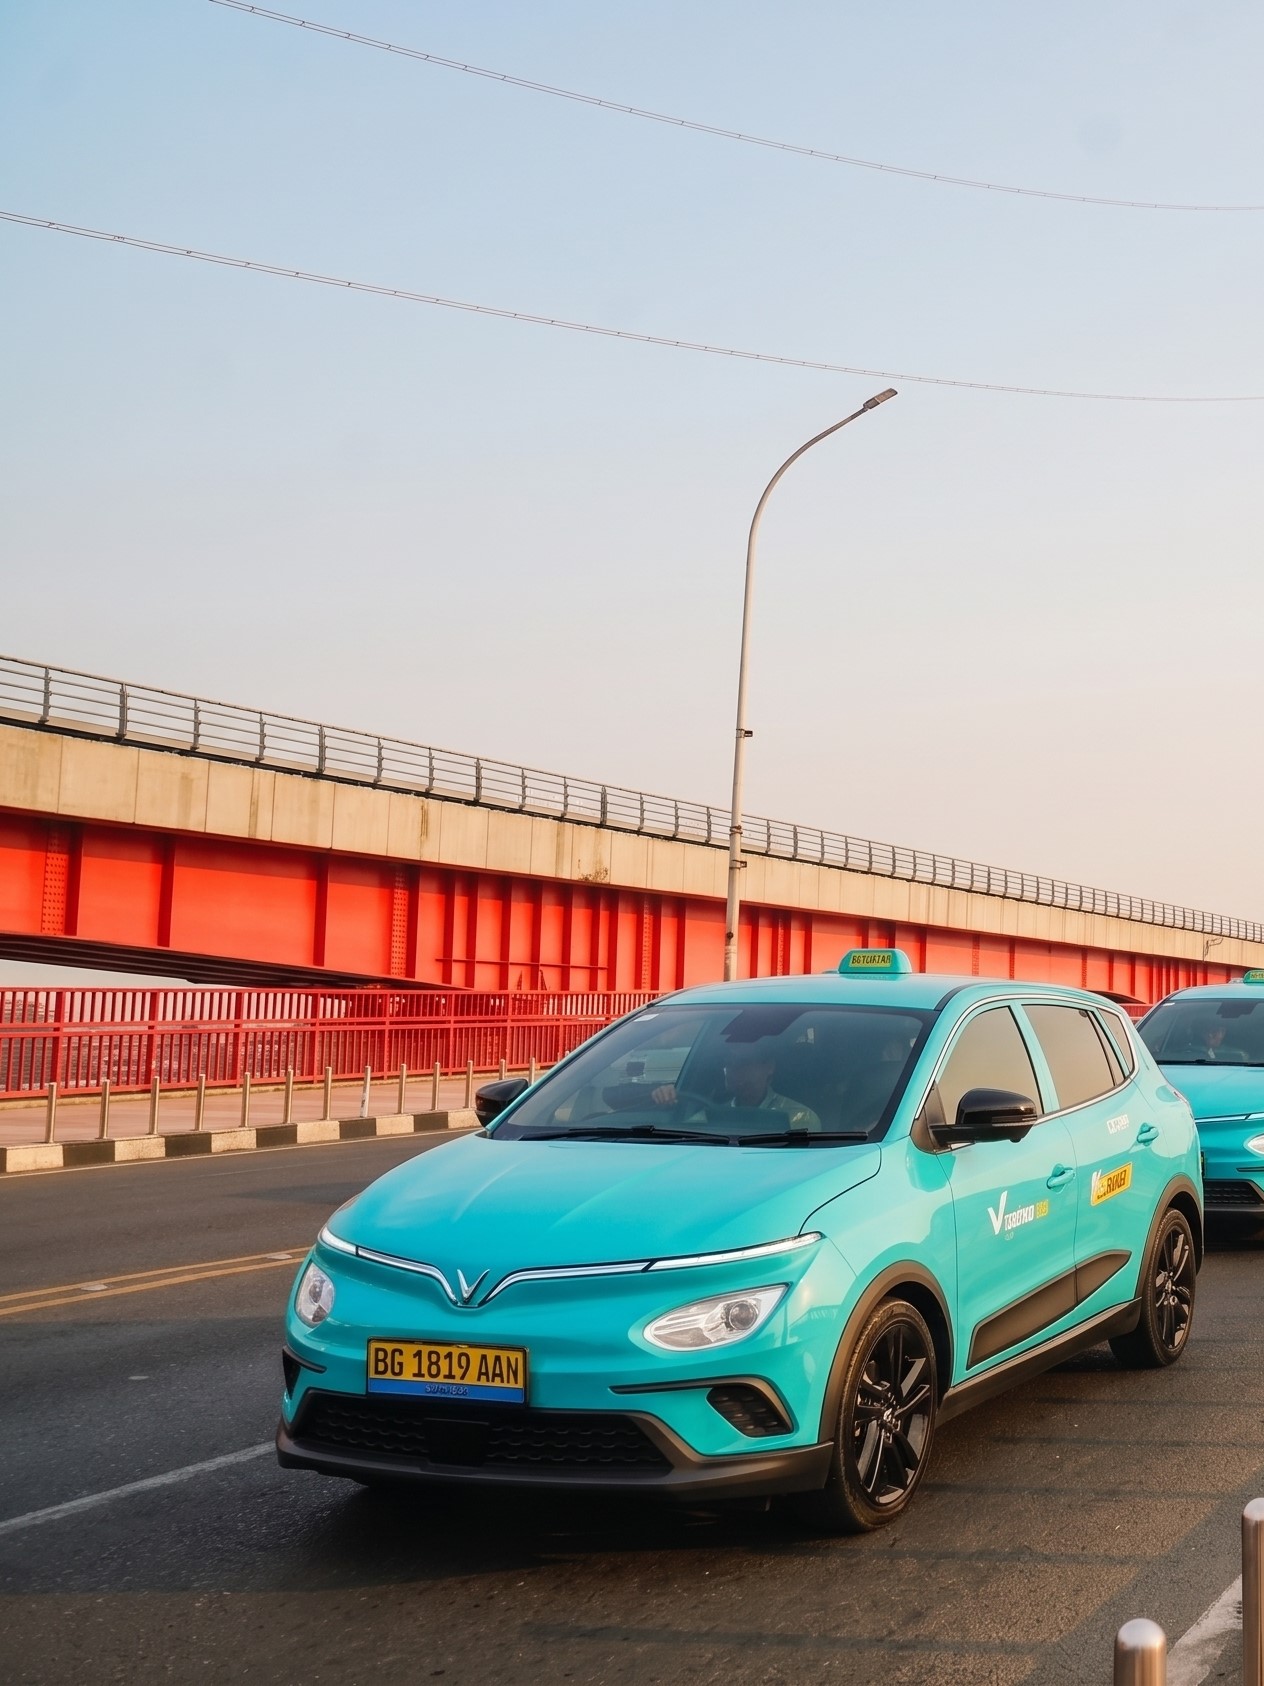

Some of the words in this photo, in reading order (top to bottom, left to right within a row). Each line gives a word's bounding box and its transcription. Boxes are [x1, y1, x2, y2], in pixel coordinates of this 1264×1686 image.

[374, 1347, 404, 1377] BG
[412, 1349, 471, 1381] 1819
[477, 1354, 519, 1385] AAN
